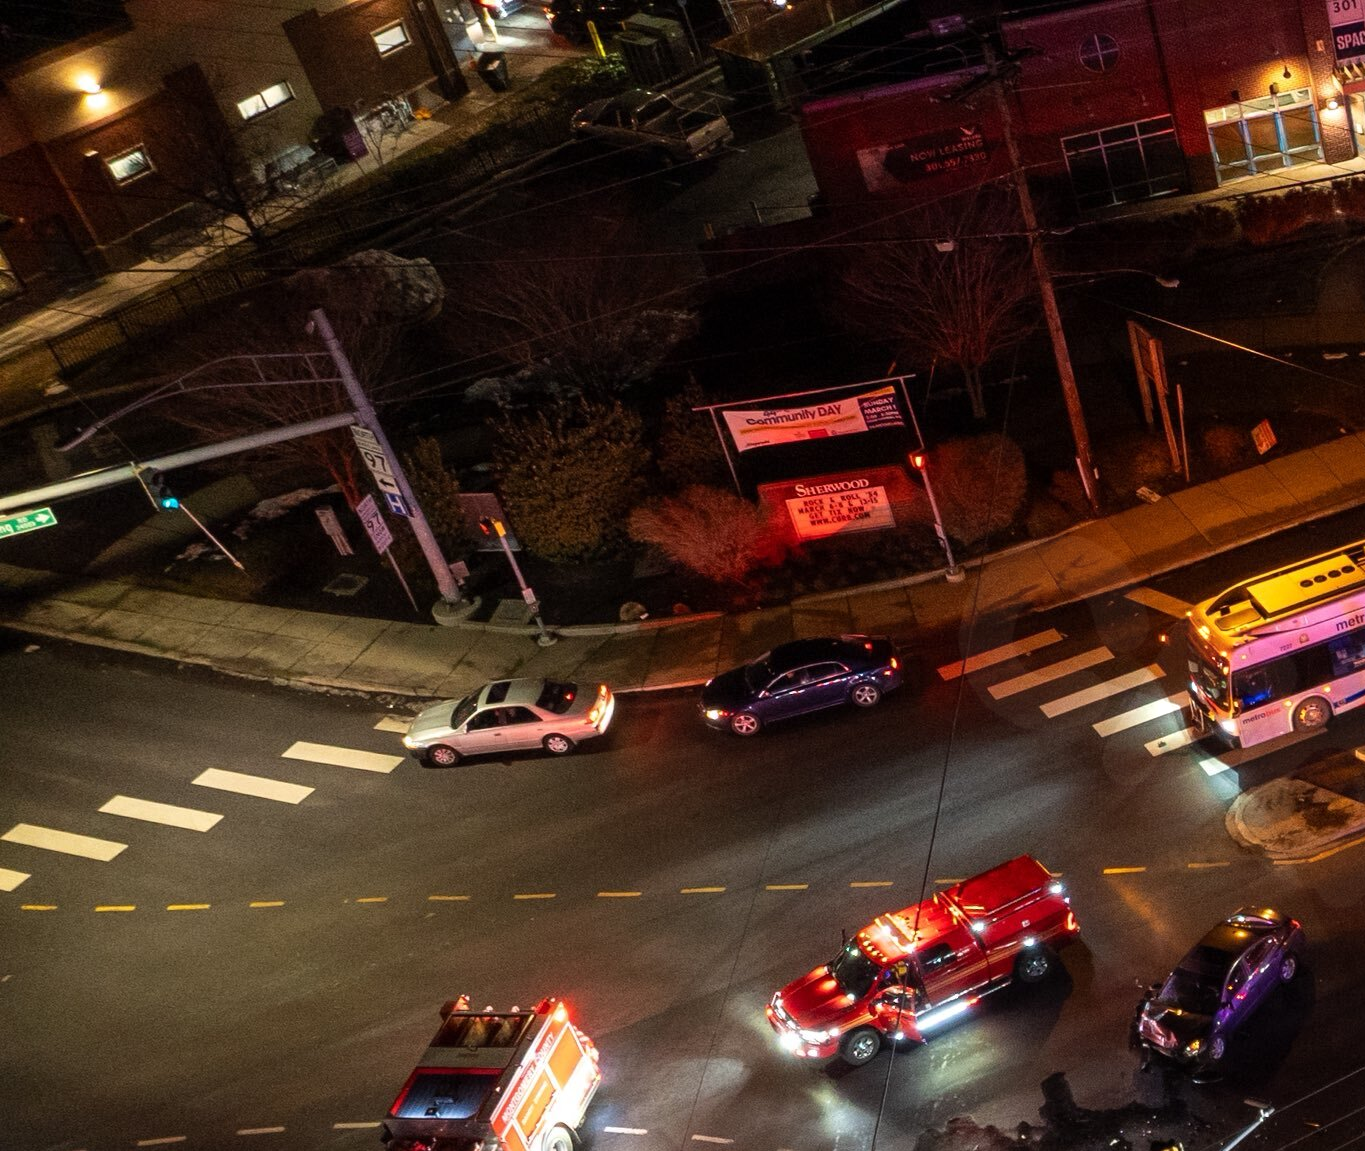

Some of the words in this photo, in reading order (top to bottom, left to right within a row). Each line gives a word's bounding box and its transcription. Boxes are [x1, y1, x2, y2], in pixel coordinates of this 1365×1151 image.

[910, 149, 936, 162] NOW
[939, 139, 984, 156] LEASING
[862, 397, 894, 409] SUNDAY
[864, 405, 892, 415] MARCH
[746, 407, 816, 426] Community
[819, 404, 842, 417] DAY
[364, 452, 387, 473] 97
[795, 479, 869, 497] SHERWOOD
[803, 499, 824, 507] ROCK
[840, 493, 860, 501] ROLL
[798, 506, 825, 514] MARCH
[808, 511, 824, 519] GET
[829, 508, 842, 516] TIX
[848, 506, 865, 514] NOW
[1242, 707, 1282, 725] metrobus
